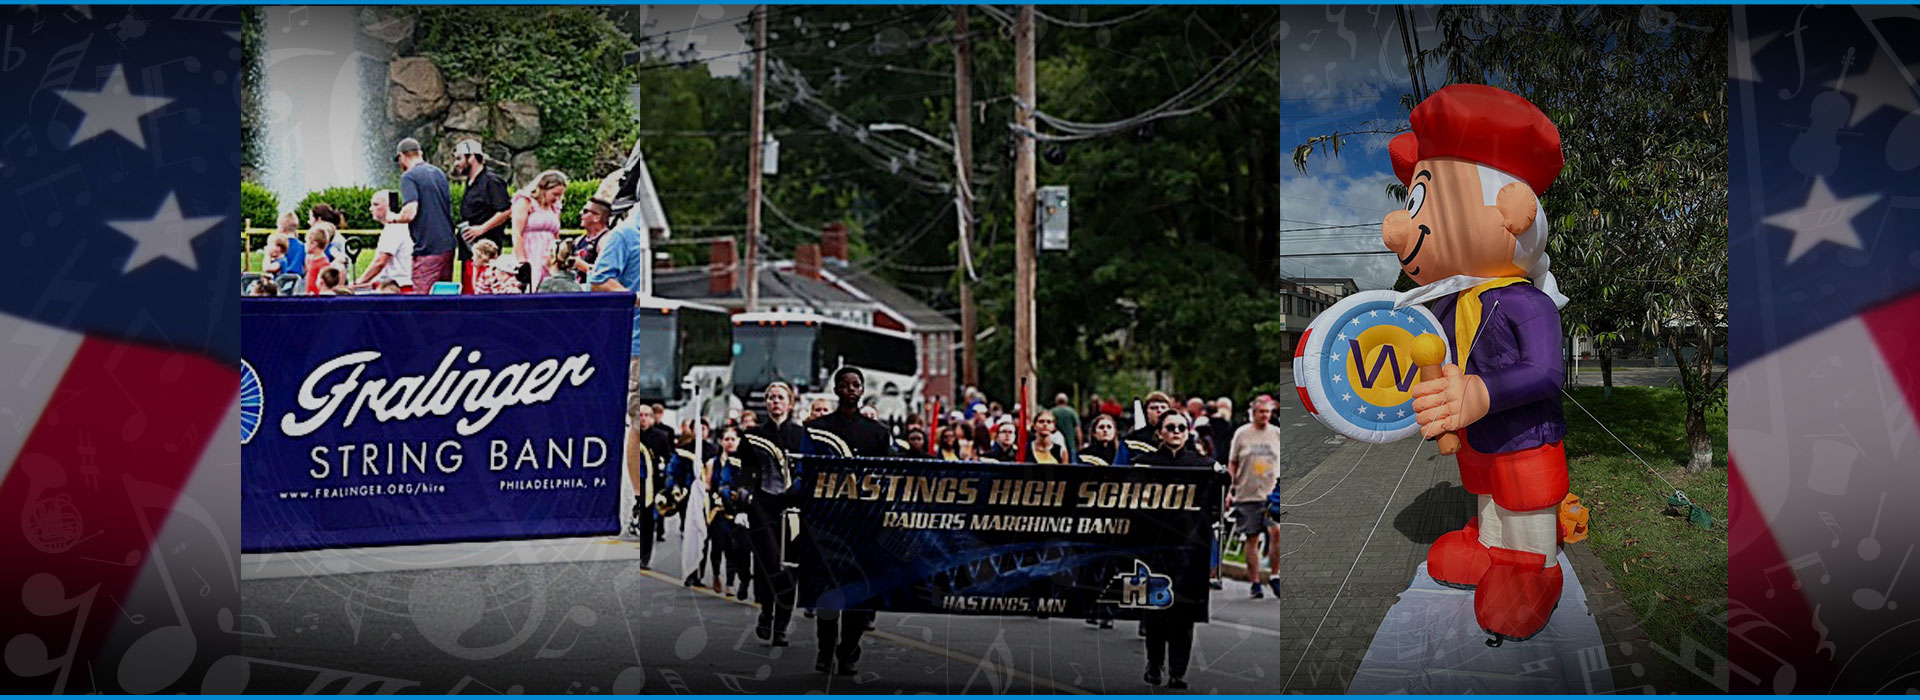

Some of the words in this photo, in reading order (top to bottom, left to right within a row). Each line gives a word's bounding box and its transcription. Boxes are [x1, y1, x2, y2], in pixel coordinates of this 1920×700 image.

[280, 345, 595, 436] Fralinger
[309, 440, 464, 479] STRING
[489, 436, 608, 471] BAND
[279, 482, 446, 499] www.FRALINGER.ORG/hire
[500, 478, 587, 490] PHILADELPHIA,
[593, 477, 607, 487] PA
[814, 471, 979, 506] HASTINGS
[988, 477, 1068, 508] HIGH
[1076, 481, 1202, 511] SCHOOL
[883, 511, 967, 530] RAIDERS
[970, 514, 1073, 533] MARCHING
[1076, 517, 1131, 535] BAND
[1037, 597, 1067, 613] MN
